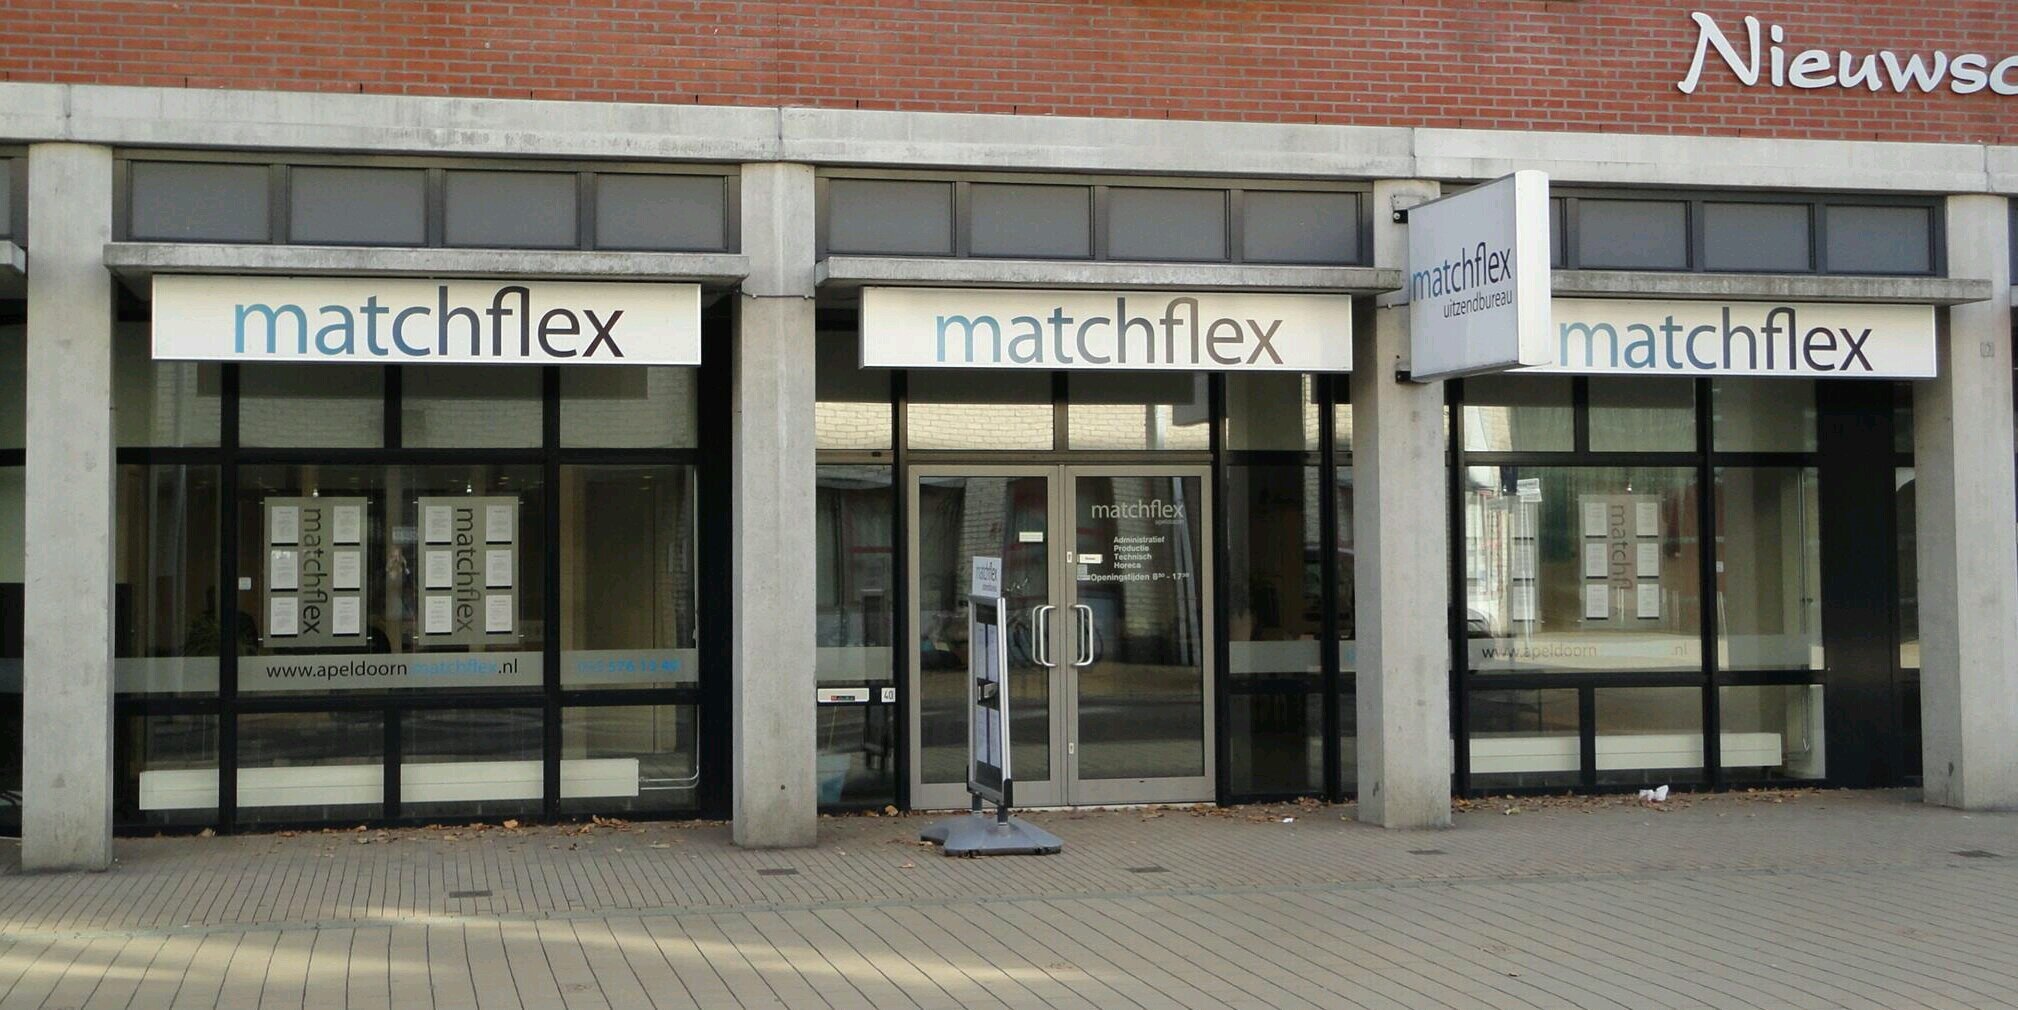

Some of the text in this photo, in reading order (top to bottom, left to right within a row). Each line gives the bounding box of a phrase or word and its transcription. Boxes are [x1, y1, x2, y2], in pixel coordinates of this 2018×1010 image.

[1412, 241, 1512, 301] matchflex
[233, 285, 625, 358] matchflex
[936, 296, 1284, 366] matchflex
[1443, 290, 1513, 318] uitzendbureau
[1559, 306, 1874, 372] matchflex
[1091, 499, 1184, 519] matchflex
[302, 508, 328, 634] matchflex
[456, 508, 480, 632] matchflex
[1090, 573, 1150, 582] Openingstijden
[883, 690, 894, 700] 40
